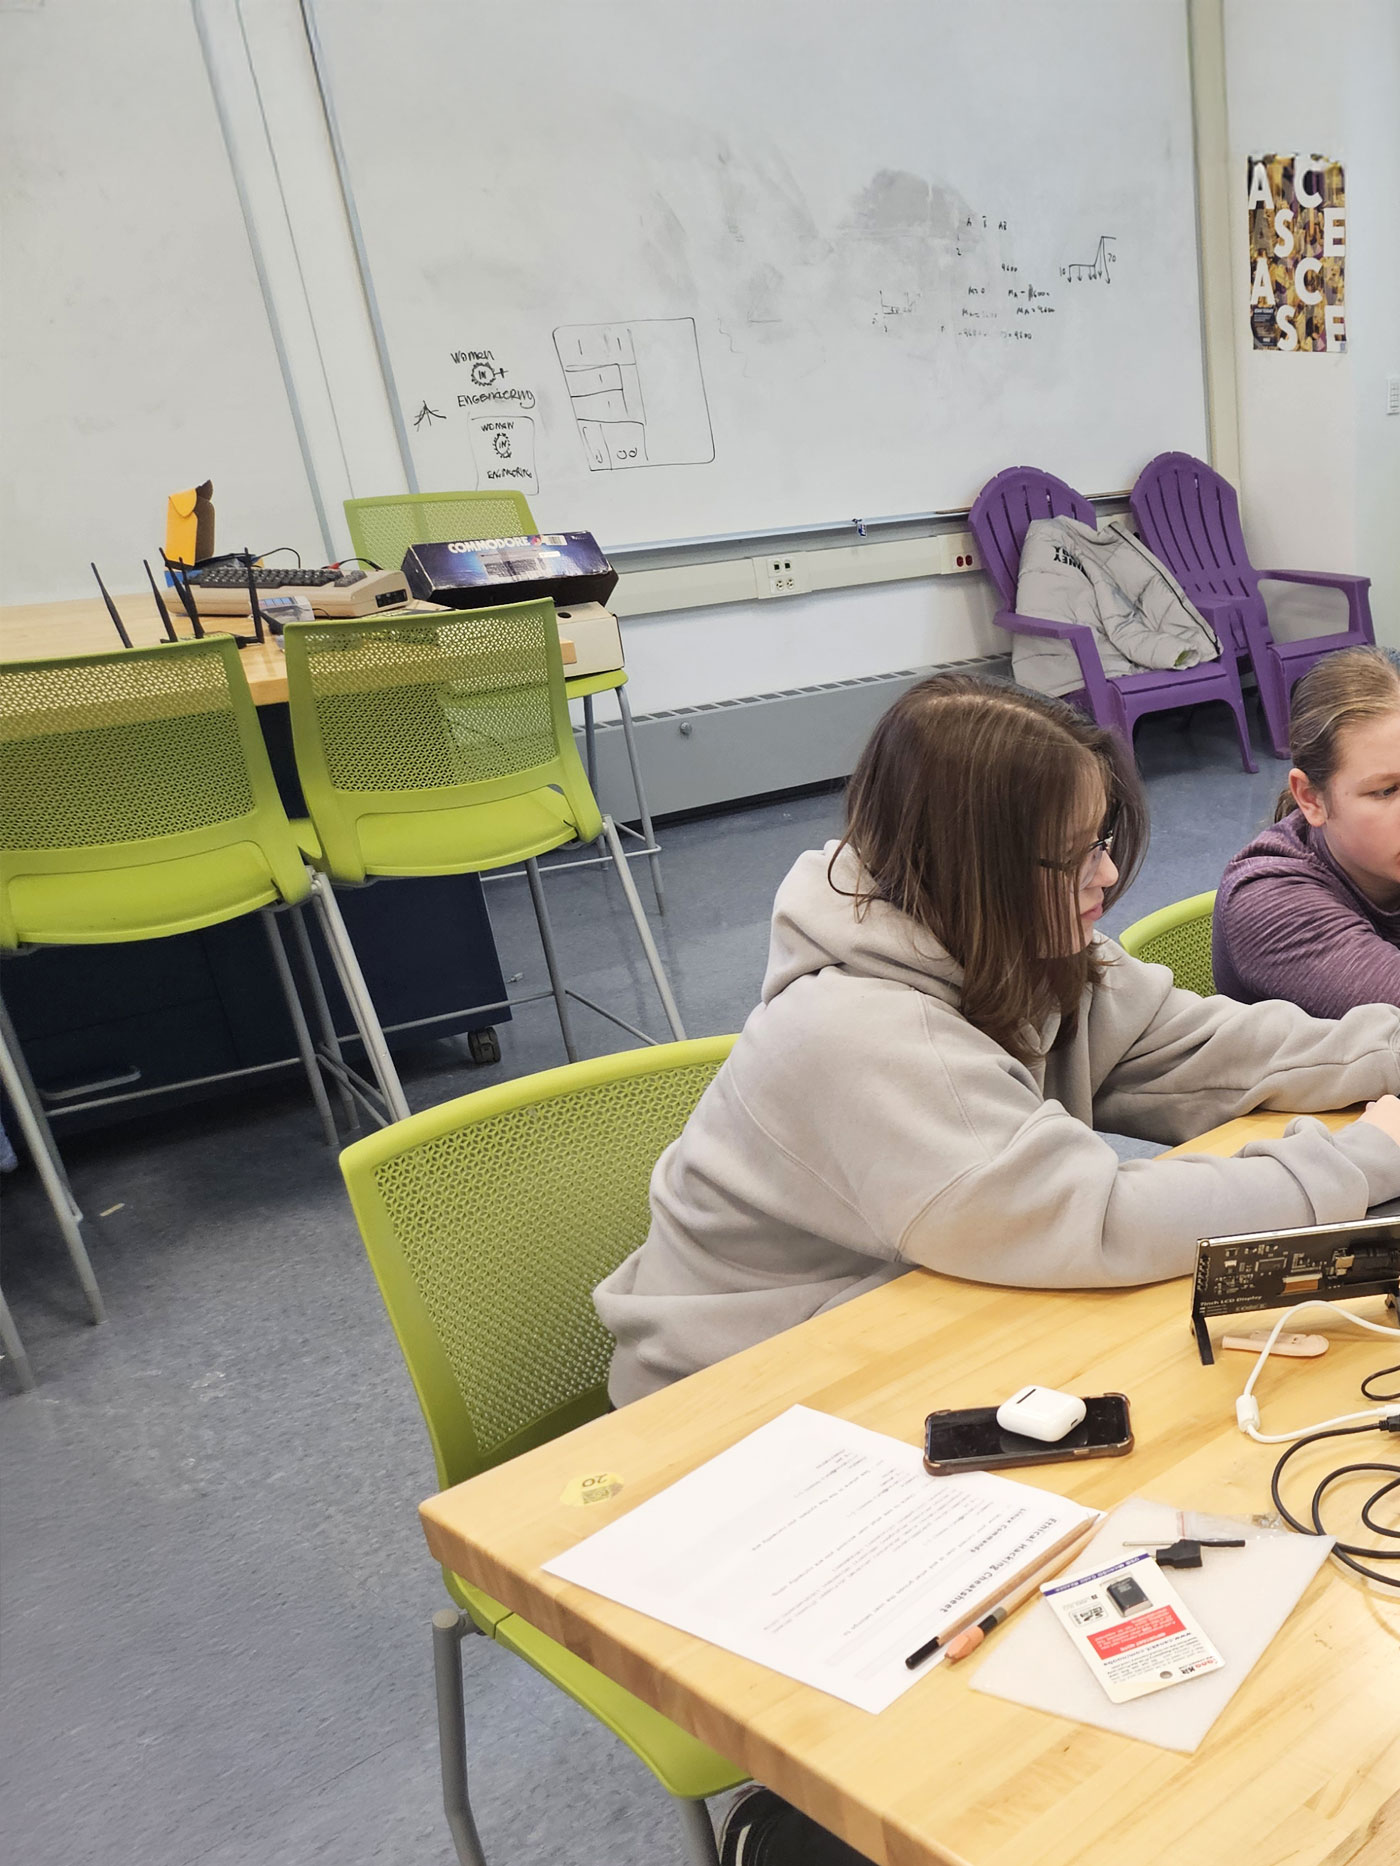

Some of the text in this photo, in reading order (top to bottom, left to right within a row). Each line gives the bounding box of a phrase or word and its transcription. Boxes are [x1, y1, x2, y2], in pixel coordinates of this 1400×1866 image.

[448, 536, 530, 554] COMMODORE
[968, 1508, 1027, 1553] Linux Commands
[937, 1517, 1058, 1614] Ethical Hacking Cheatsheet
